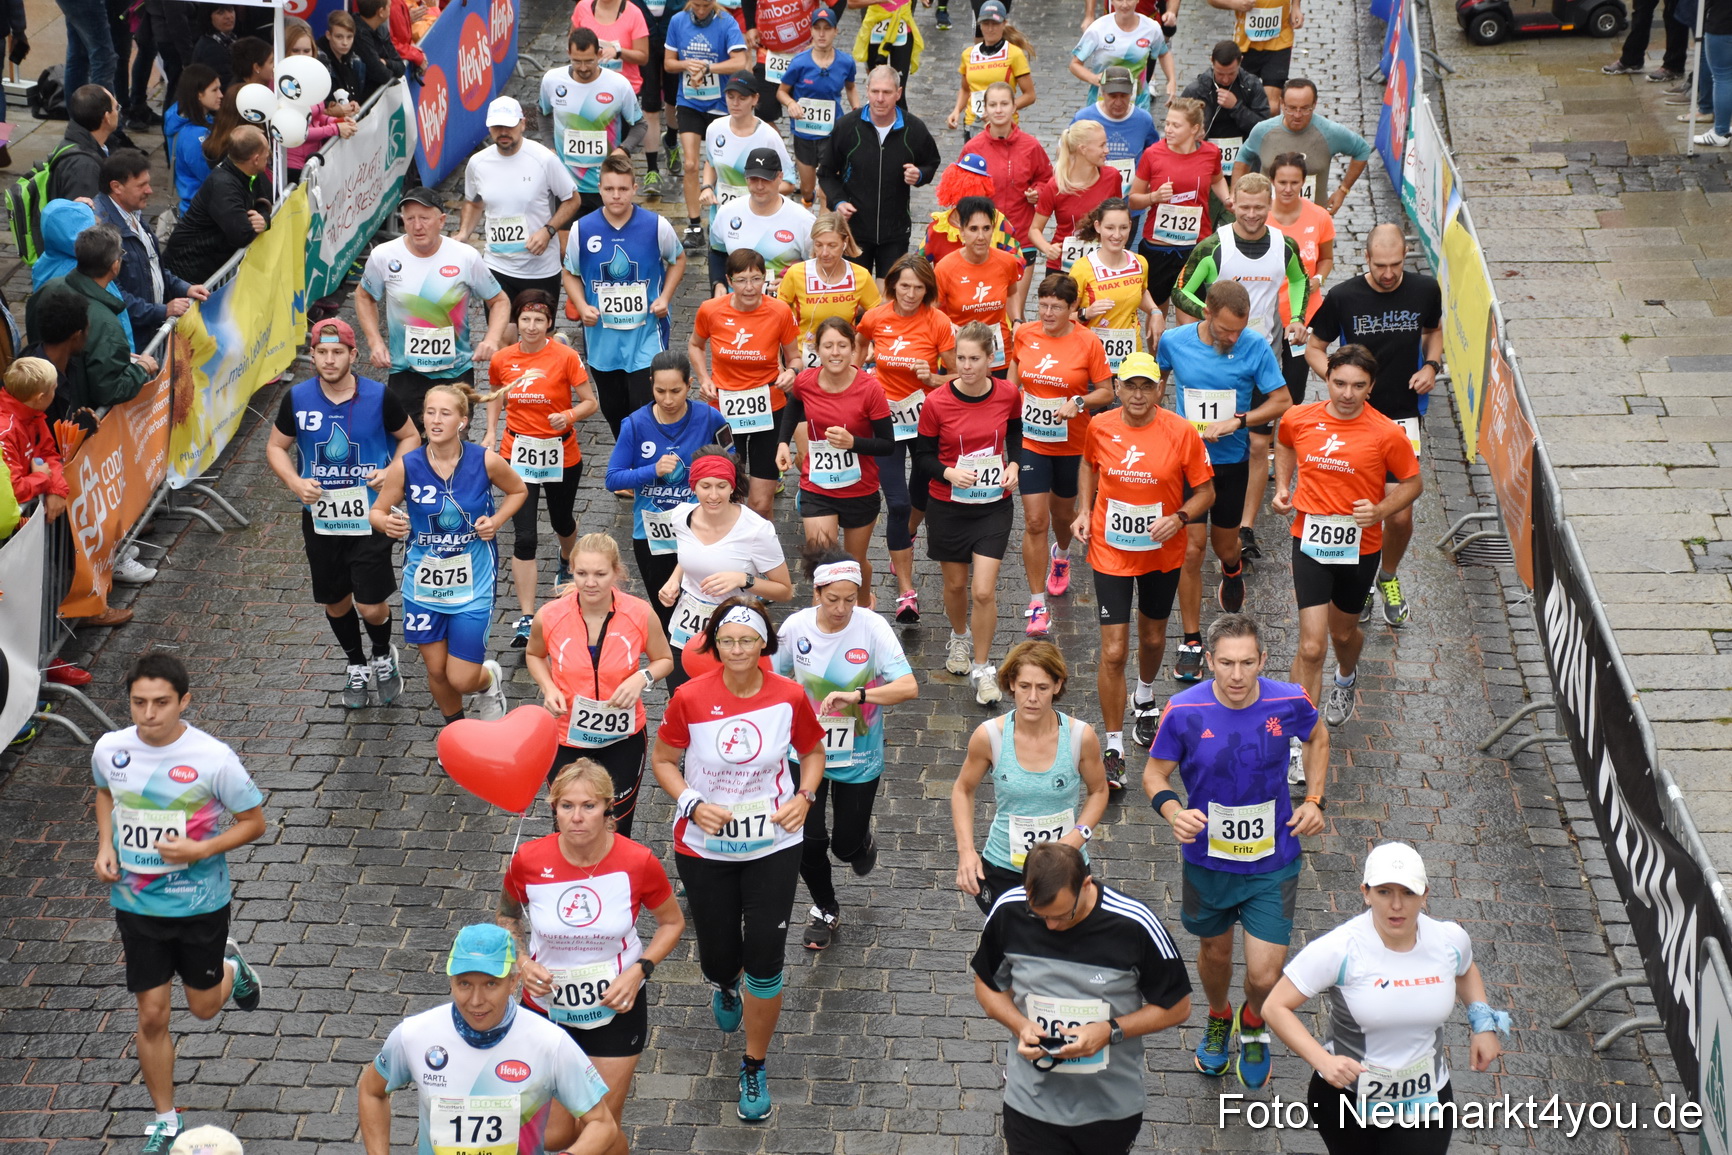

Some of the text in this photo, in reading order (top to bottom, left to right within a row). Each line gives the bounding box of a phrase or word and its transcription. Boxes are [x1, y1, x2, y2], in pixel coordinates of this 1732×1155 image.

[1249, 15, 1280, 29] 3000
[1255, 29, 1276, 38] OTTO
[458, 30, 491, 96] Hervis
[418, 83, 448, 153] Hervis
[802, 106, 832, 122] 2316
[569, 139, 603, 155] 2015
[1160, 212, 1197, 232] 2132
[490, 225, 525, 242] 3022
[587, 234, 602, 253] 6
[1098, 282, 1120, 292] MAX
[604, 296, 644, 313] 2508
[806, 294, 856, 305] MAX BÖGL
[962, 299, 1002, 312] funrunners
[614, 316, 635, 325] Daniel
[410, 337, 451, 355] 2202
[719, 346, 761, 356] funrunners
[1104, 340, 1134, 356] 683
[877, 353, 916, 364] funrunners
[1021, 368, 1063, 383] funrunners
[1033, 378, 1069, 389] neumarkt
[725, 395, 767, 416] 2298
[1199, 401, 1218, 420] 11
[296, 410, 323, 431] 13
[739, 418, 756, 428] Erika
[1028, 425, 1057, 438] Michaela
[517, 446, 559, 466] 2613
[641, 441, 657, 459] 9
[815, 451, 854, 471] 2310
[1306, 453, 1350, 467] funrunners
[525, 468, 549, 477] Brigitte
[1108, 466, 1152, 478] funrunners
[1317, 462, 1355, 475] neumarkt
[322, 478, 354, 486] BASKETS
[830, 474, 840, 482] Evi
[1119, 476, 1158, 485] neumarkt
[410, 484, 437, 504] 22
[970, 490, 987, 498] Julia
[318, 499, 365, 519] 2148
[324, 521, 360, 530] Korbinian
[1111, 512, 1157, 534] 3085
[1115, 535, 1137, 545] Ernst
[1308, 523, 1357, 545] 2698
[1316, 547, 1345, 558] Thomas
[420, 567, 468, 586] 2675
[405, 612, 432, 631] 22
[796, 654, 812, 664] PARTL
[848, 652, 867, 660] Hervis
[576, 708, 630, 734] 2293
[171, 768, 195, 780] Hervis
[735, 770, 750, 778] MIT
[1221, 817, 1264, 841] 303
[719, 840, 749, 852] INA
[1023, 826, 1064, 852] 327
[1233, 845, 1254, 854] Fritz
[570, 963, 609, 980] BOCK
[1393, 975, 1444, 988] KLEBL
[566, 1008, 603, 1022] Annette
[1060, 1005, 1099, 1016] BOCK
[500, 1063, 527, 1077] Hervis
[423, 1073, 448, 1083] PARTL
[1367, 1072, 1432, 1101] 2409
[470, 1098, 513, 1110] BOCK
[449, 1115, 503, 1144] 173
